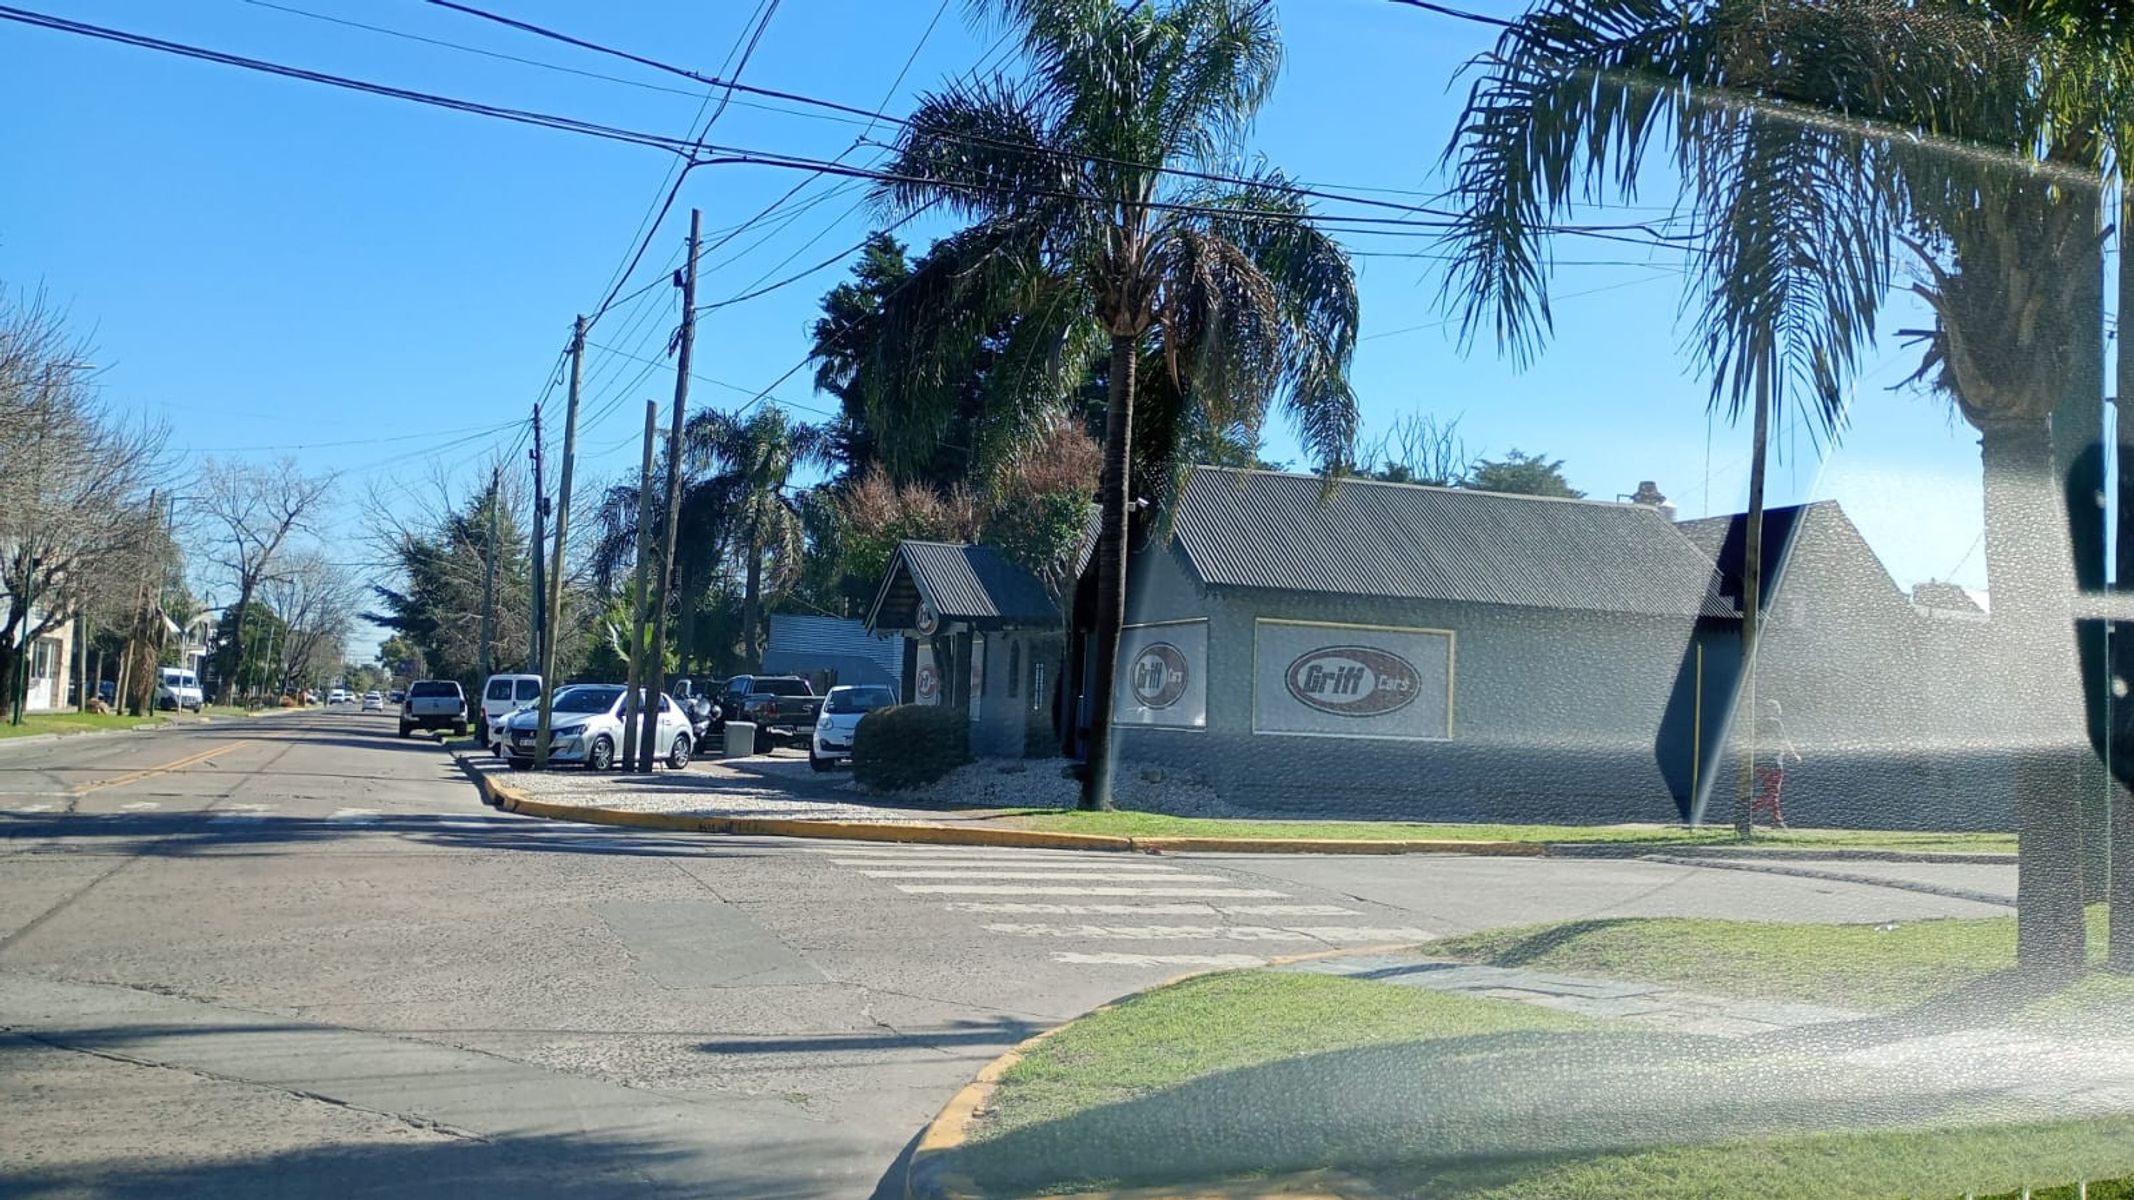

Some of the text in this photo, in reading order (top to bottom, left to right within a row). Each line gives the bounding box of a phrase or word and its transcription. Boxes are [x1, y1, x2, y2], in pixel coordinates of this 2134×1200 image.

[1137, 662, 1163, 689] Griff
[1302, 664, 1410, 695] Griff Cars
